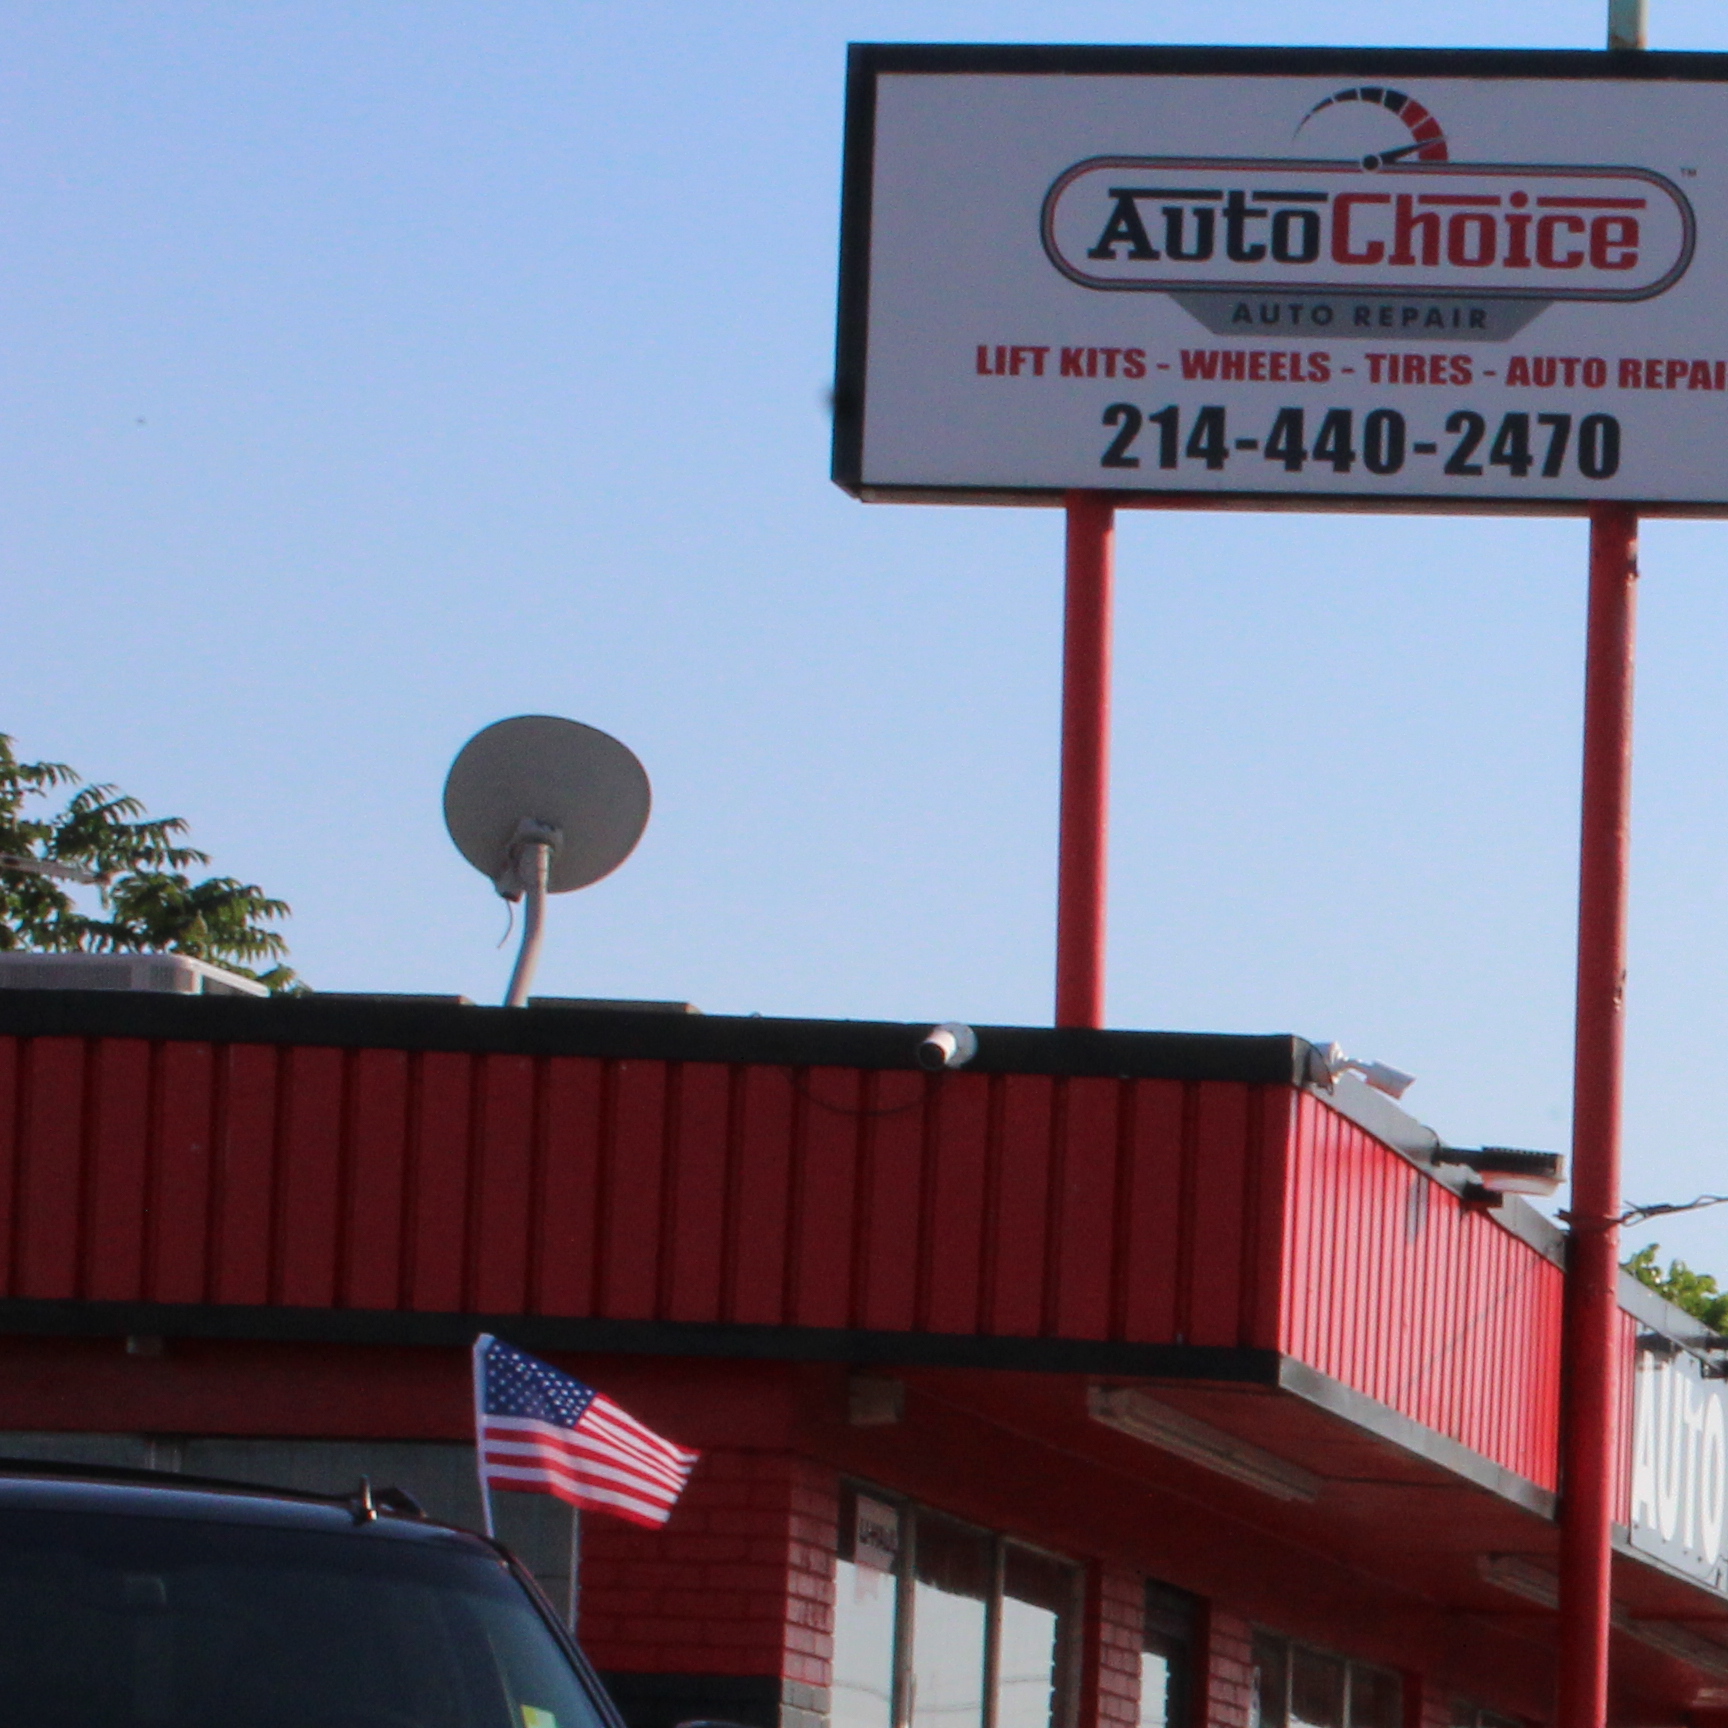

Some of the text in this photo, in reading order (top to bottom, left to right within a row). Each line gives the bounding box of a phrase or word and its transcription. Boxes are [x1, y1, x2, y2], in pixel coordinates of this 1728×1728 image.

[1230, 301, 1489, 330] AUTO REPAIR
[975, 344, 1051, 377] LIFT
[1059, 346, 1147, 380] KITS
[1179, 349, 1332, 384] WHEELS
[1363, 352, 1474, 387] TIRES
[1504, 355, 1608, 390] AUTO
[1099, 401, 1622, 481] 214-440-2470
[1631, 1350, 1726, 1566] AUTO
